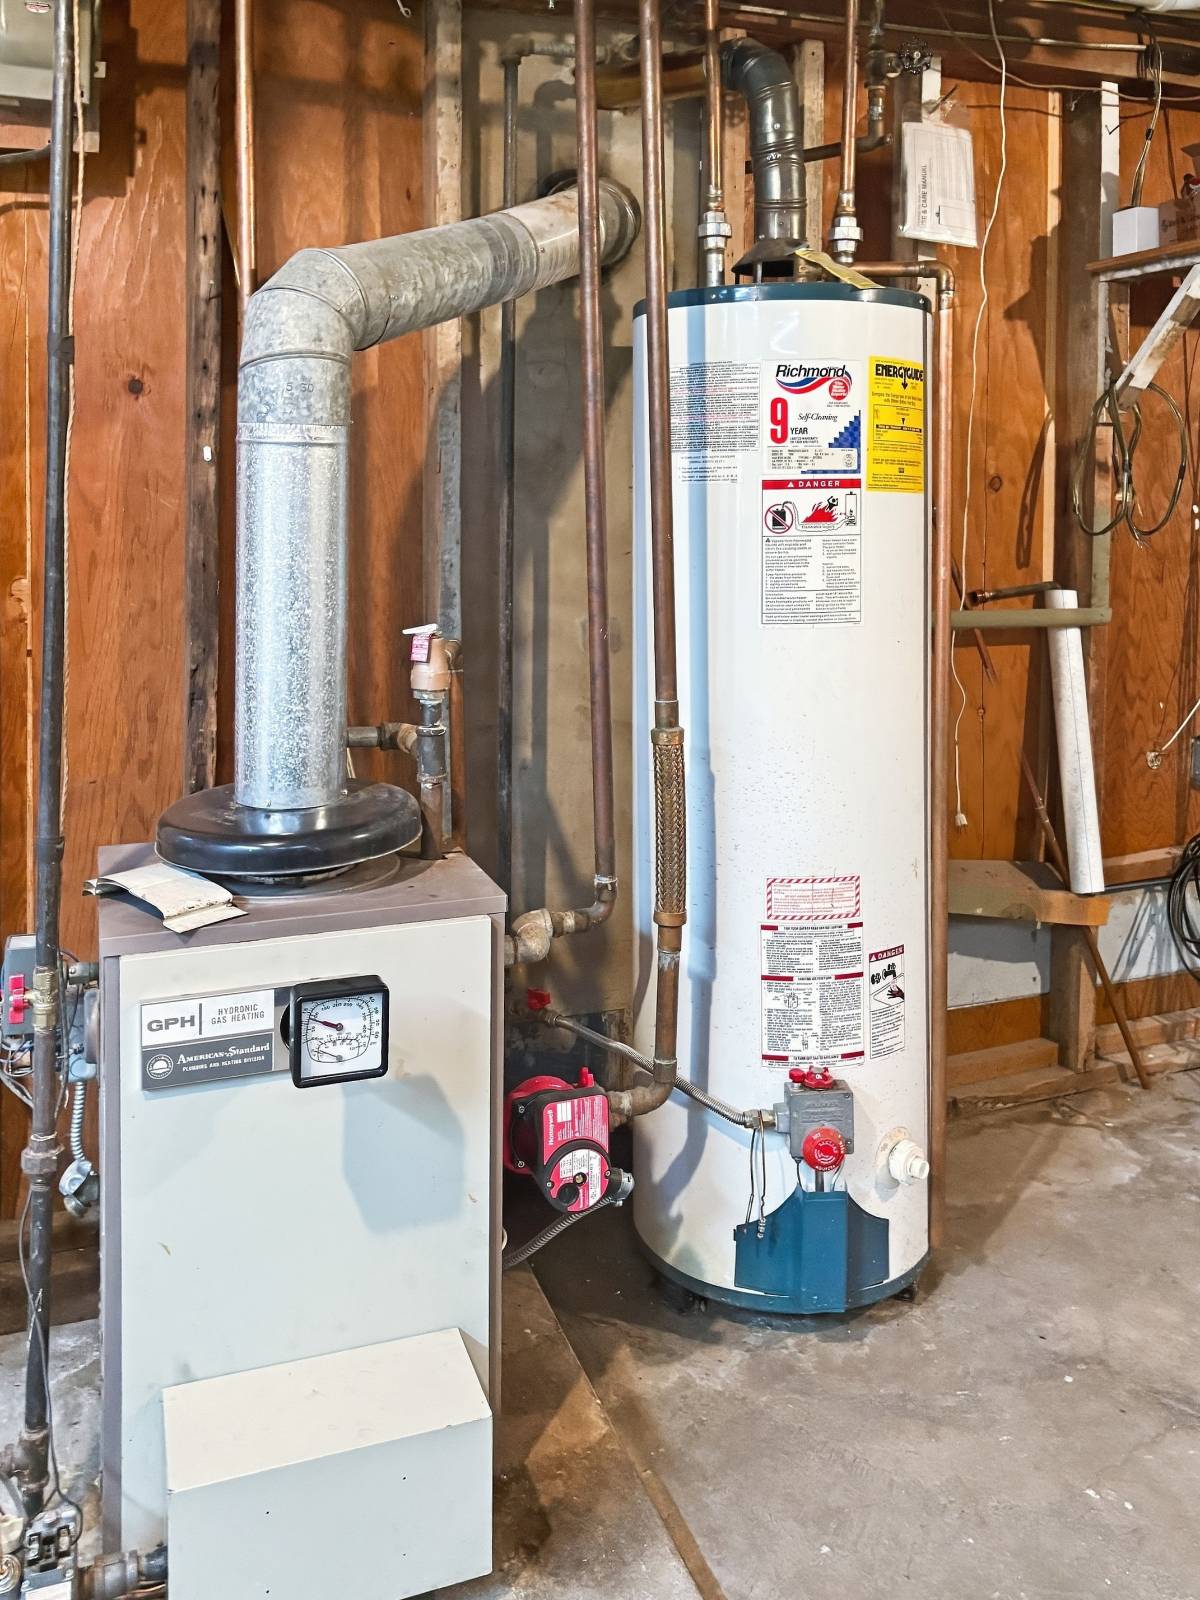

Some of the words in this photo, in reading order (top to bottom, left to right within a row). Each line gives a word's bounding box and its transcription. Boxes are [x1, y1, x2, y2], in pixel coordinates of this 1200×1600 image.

[776, 364, 846, 378] Richmond
[770, 397, 789, 444] 9
[798, 412, 838, 423] Self-Cleaning
[790, 427, 809, 435] YEAR
[877, 947, 903, 960] DANGER
[217, 1003, 259, 1016] HYDRONIC
[147, 1014, 196, 1032] GPH
[211, 1015, 227, 1025] GAS
[231, 1010, 265, 1023] HEATING
[182, 1063, 208, 1072] PLUMBING
[210, 1061, 220, 1069] AND
[222, 1058, 242, 1068] HEATING
[243, 1055, 265, 1064] DIVISION
[547, 1108, 555, 1146] Honeywell
